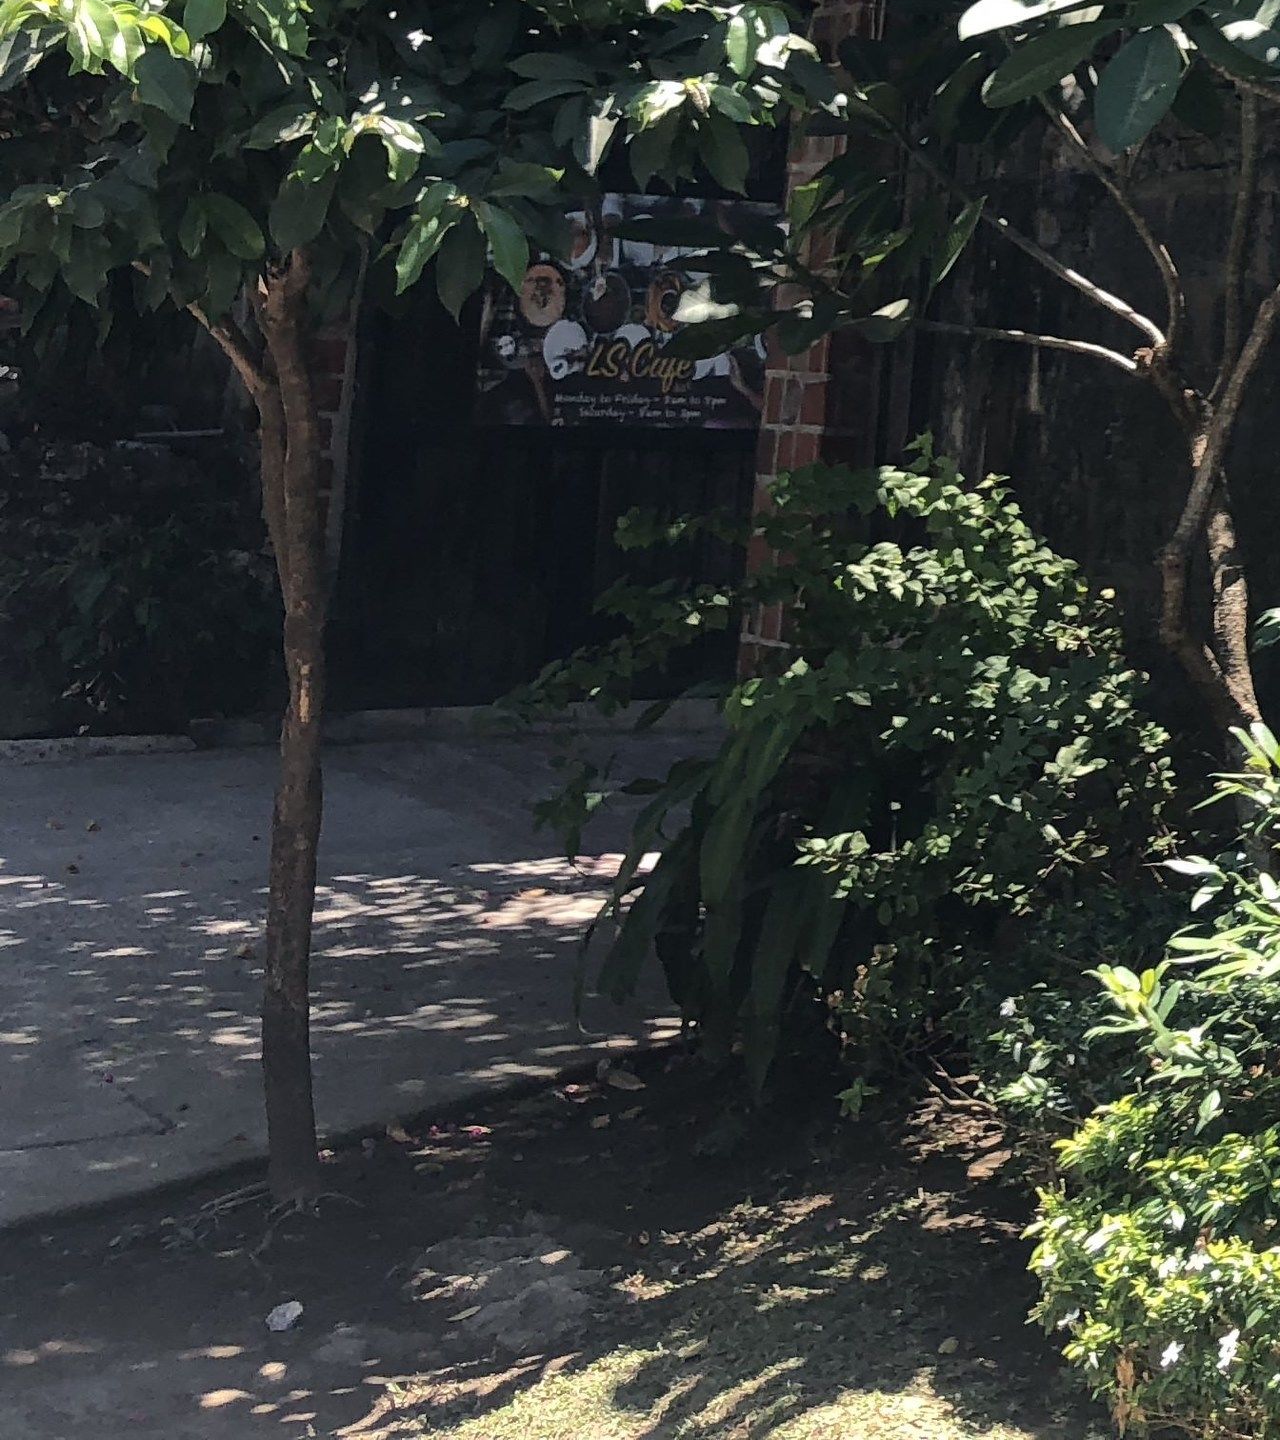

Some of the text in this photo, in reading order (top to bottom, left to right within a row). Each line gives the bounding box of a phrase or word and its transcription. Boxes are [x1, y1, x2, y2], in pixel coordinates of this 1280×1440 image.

[587, 342, 692, 393] LS Cafe
[554, 392, 596, 408] Monday
[600, 393, 611, 404] to
[689, 395, 701, 405] to
[578, 406, 625, 422] Saturday
[665, 406, 677, 418] to
